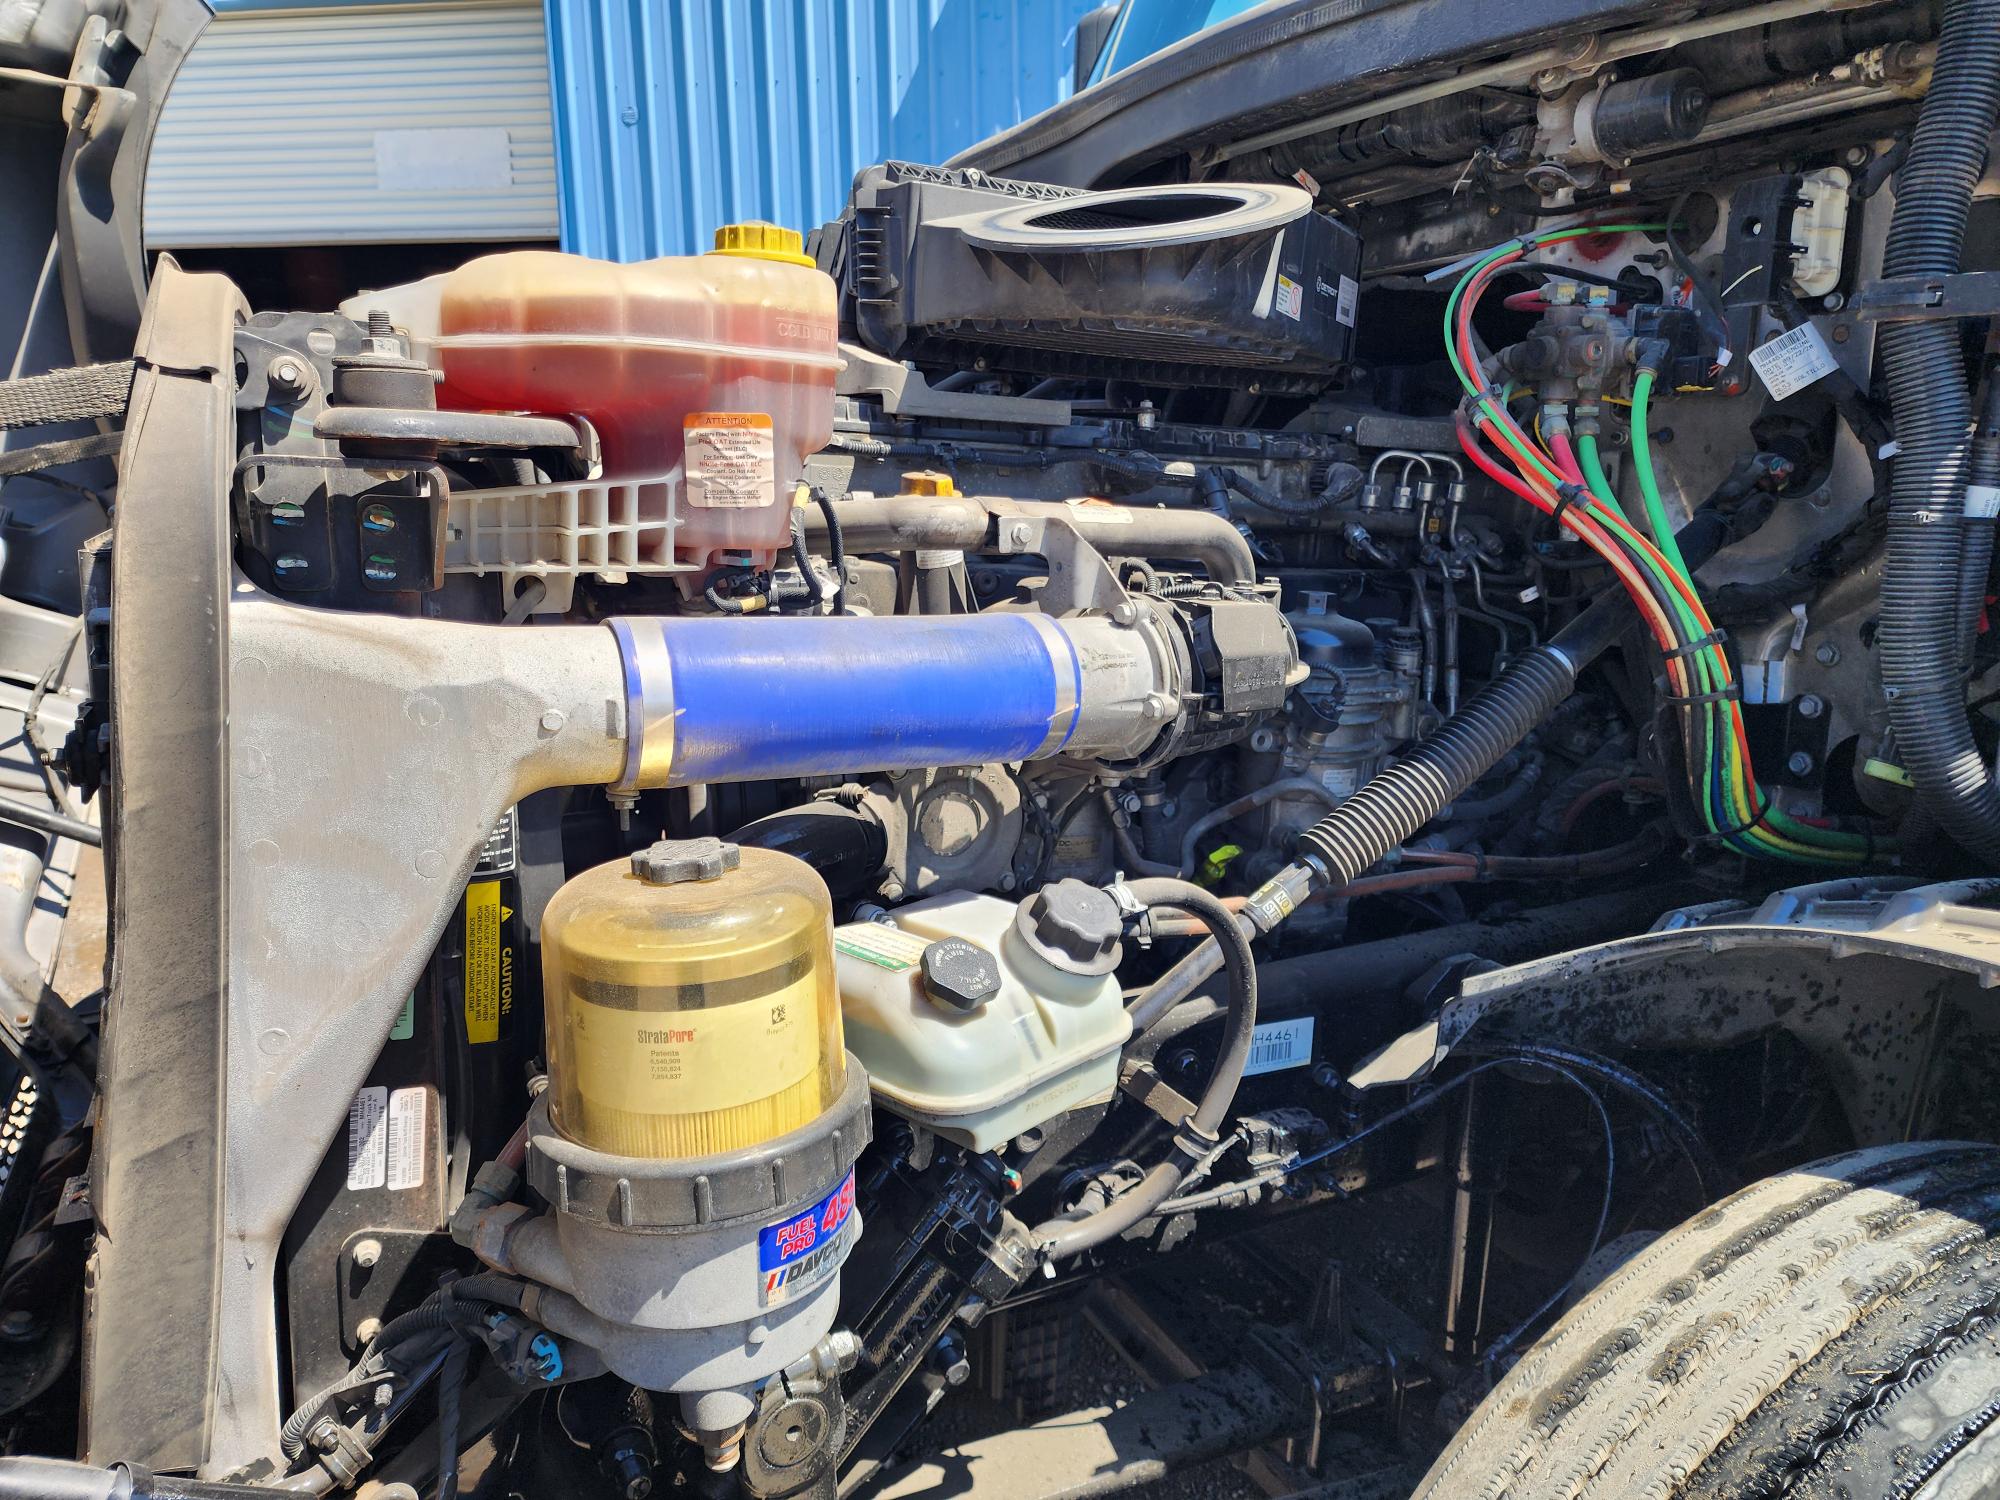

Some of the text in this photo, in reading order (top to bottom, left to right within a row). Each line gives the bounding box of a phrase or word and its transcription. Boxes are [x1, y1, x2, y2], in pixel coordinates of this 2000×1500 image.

[1321, 282, 1338, 297] DETROIT
[1278, 892, 1291, 909] NO
[935, 943, 979, 967] POWER STEERING
[944, 950, 964, 961] FLUID
[501, 947, 513, 1015] CAUTION:
[958, 968, 986, 984] OVERFILL
[776, 1214, 816, 1246] FUEL
[781, 1230, 816, 1260] PRO
[786, 1232, 842, 1284] DAVCO
